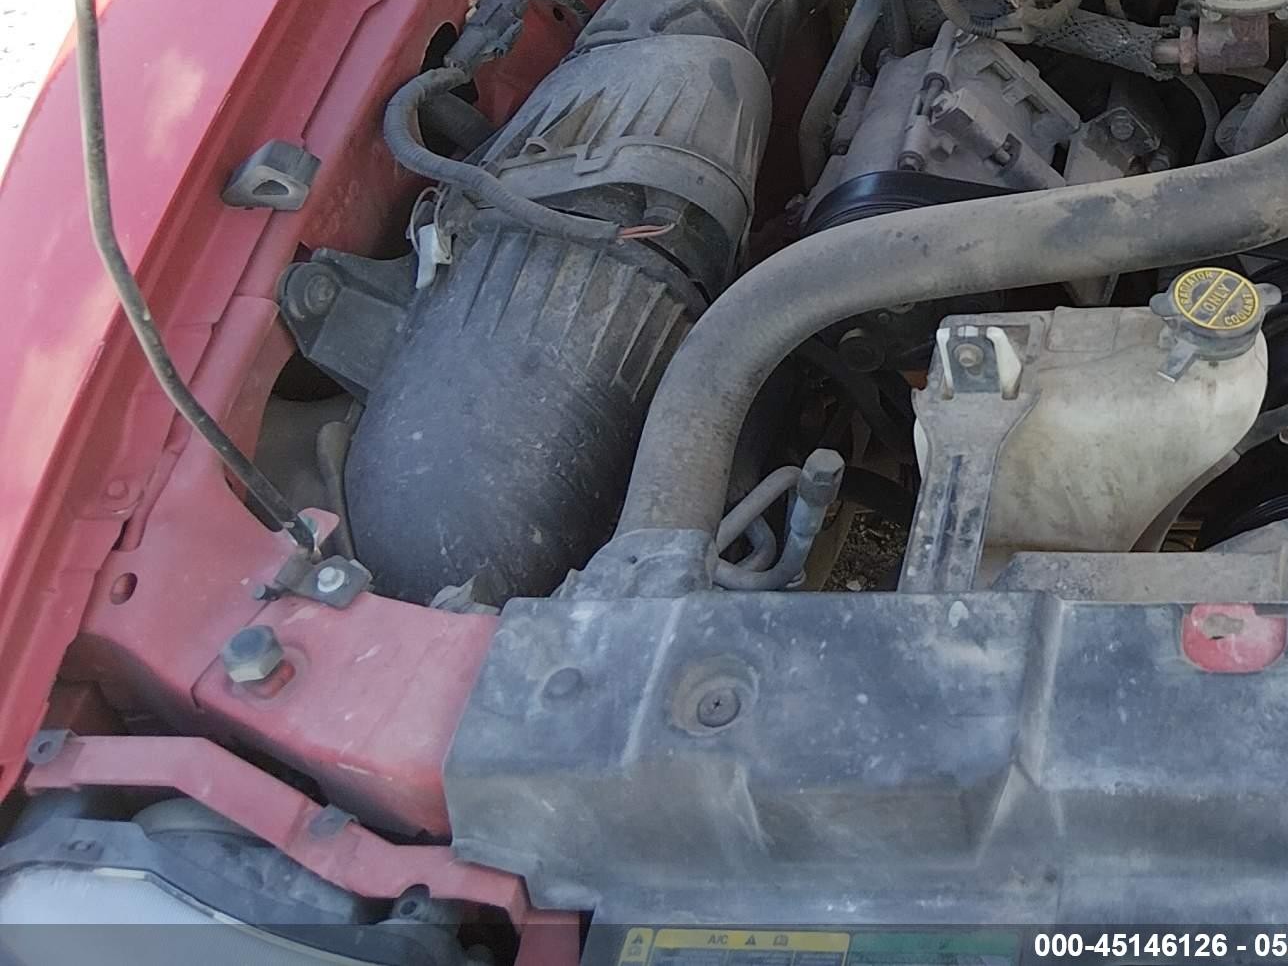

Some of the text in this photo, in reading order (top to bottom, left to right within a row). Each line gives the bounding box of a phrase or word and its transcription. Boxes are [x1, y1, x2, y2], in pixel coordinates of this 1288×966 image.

[1180, 270, 1214, 305] RADIATOR
[1202, 283, 1232, 313] ONLY
[1224, 293, 1254, 325] COOLANT
[707, 934, 729, 945] A/C
